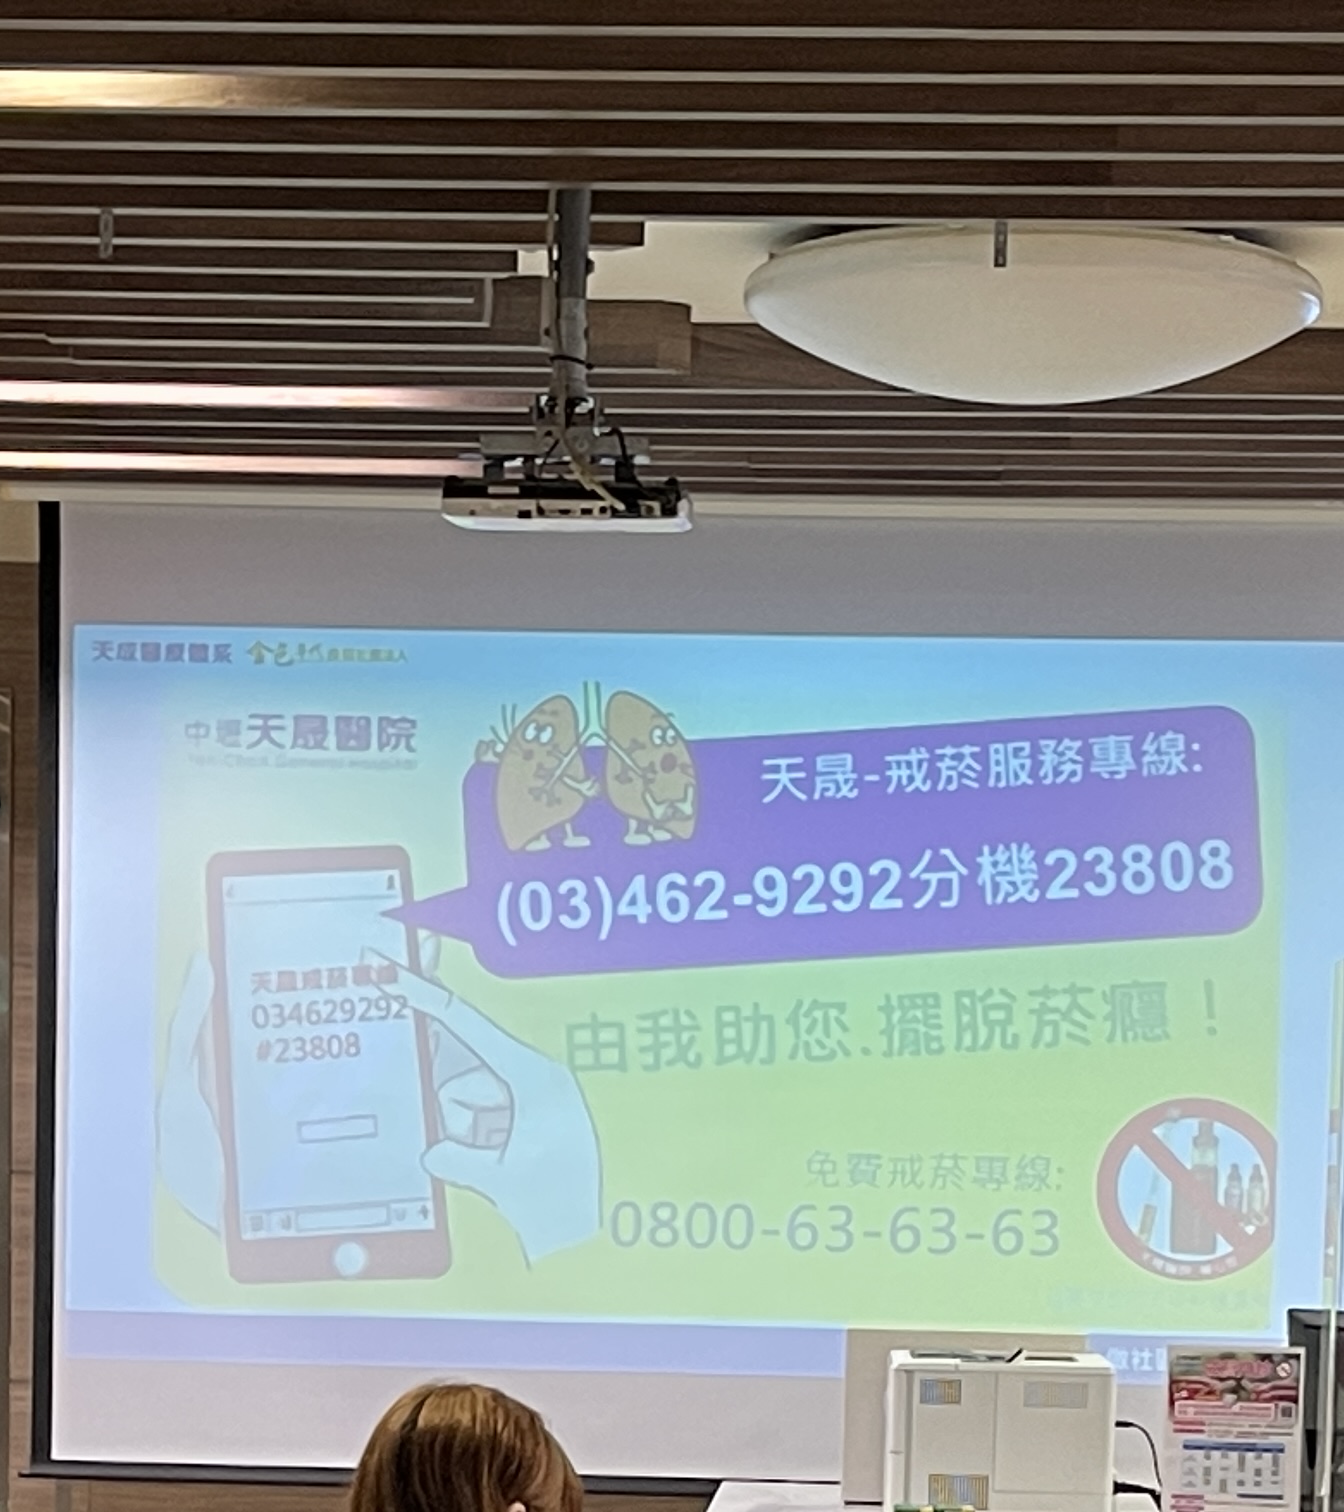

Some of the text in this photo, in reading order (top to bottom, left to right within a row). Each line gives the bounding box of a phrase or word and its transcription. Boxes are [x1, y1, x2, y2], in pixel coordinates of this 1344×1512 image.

[184, 712, 418, 754] 中壢天晟醫院
[760, 730, 1204, 804] 天晟-戒菸服務專線:
[496, 838, 1234, 947] (03)462-9292分機23808
[250, 994, 410, 1030] 034629292
[255, 1031, 362, 1064] #23808
[805, 1150, 1063, 1195] 免費戒菸專線:
[609, 1200, 1060, 1257] 0800-63-63-63
